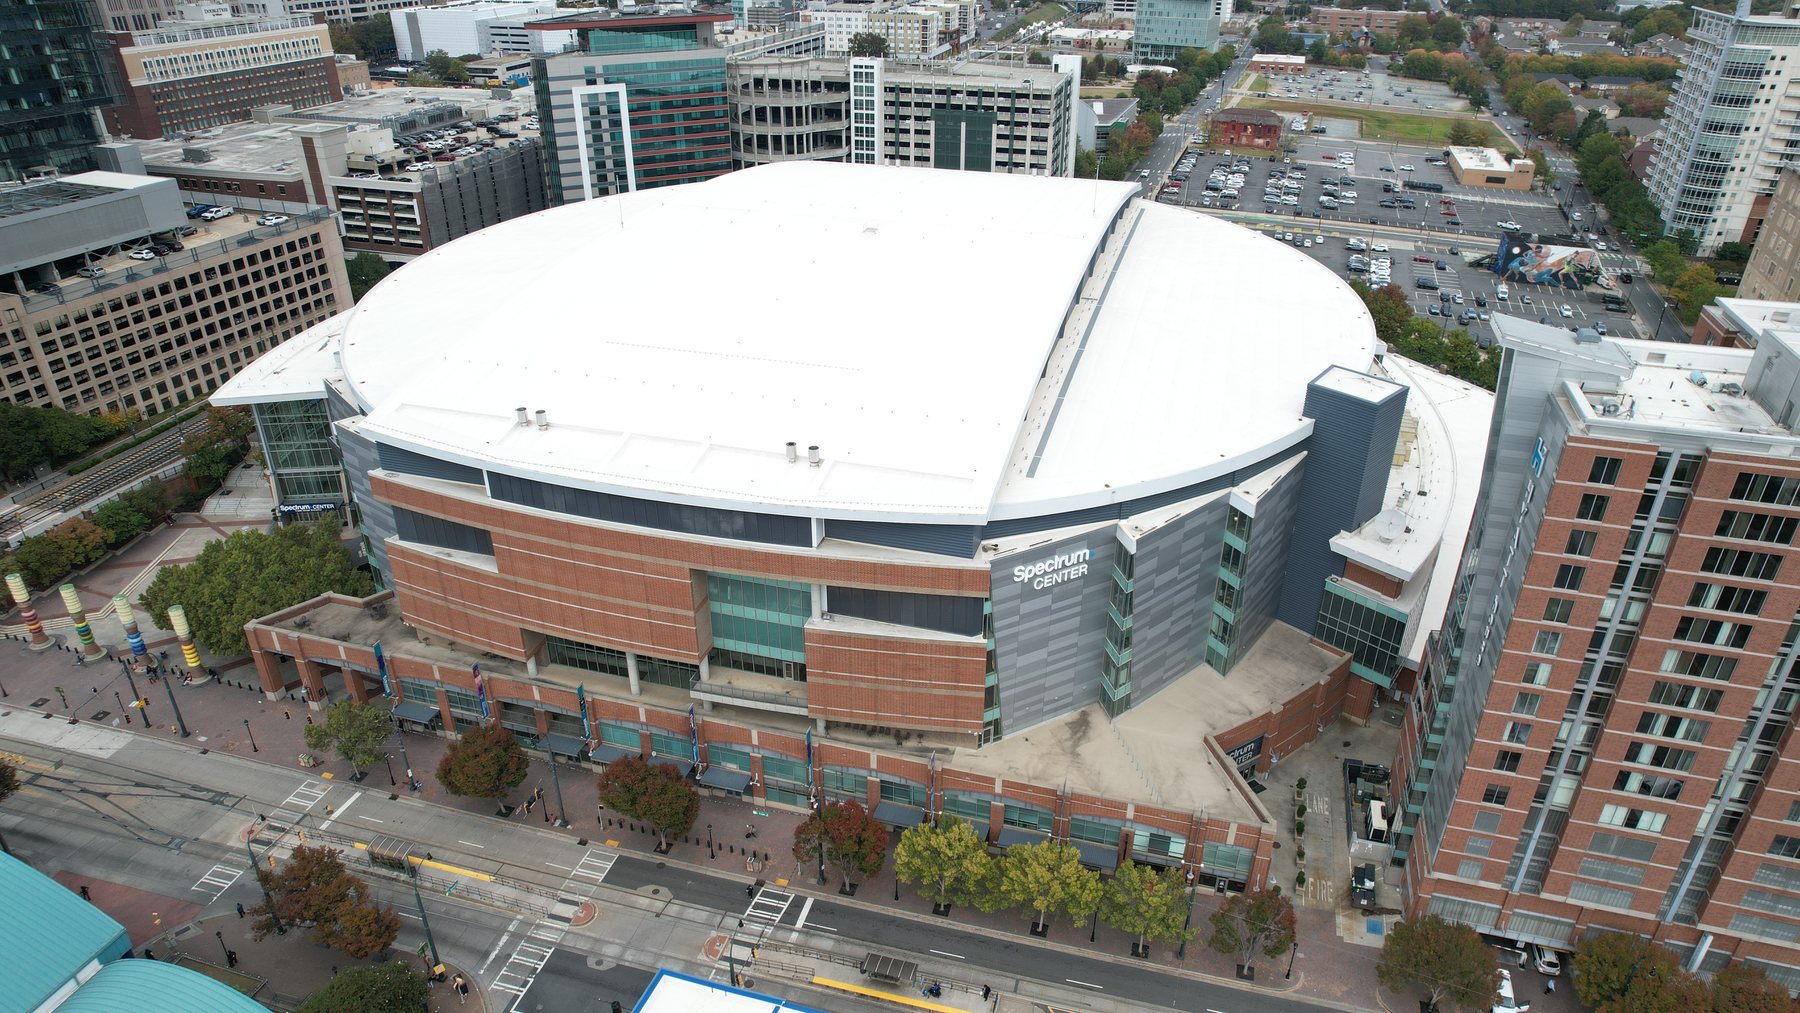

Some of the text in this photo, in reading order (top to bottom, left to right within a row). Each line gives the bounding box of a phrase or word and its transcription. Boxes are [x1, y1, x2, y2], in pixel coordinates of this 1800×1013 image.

[280, 504, 310, 512] Spectrum
[1013, 549, 1090, 583] Spectrum
[1034, 564, 1088, 590] CENTER
[1229, 743, 1255, 758] ctrum
[1306, 793, 1330, 815] LANE
[1308, 877, 1333, 903] FIRE
